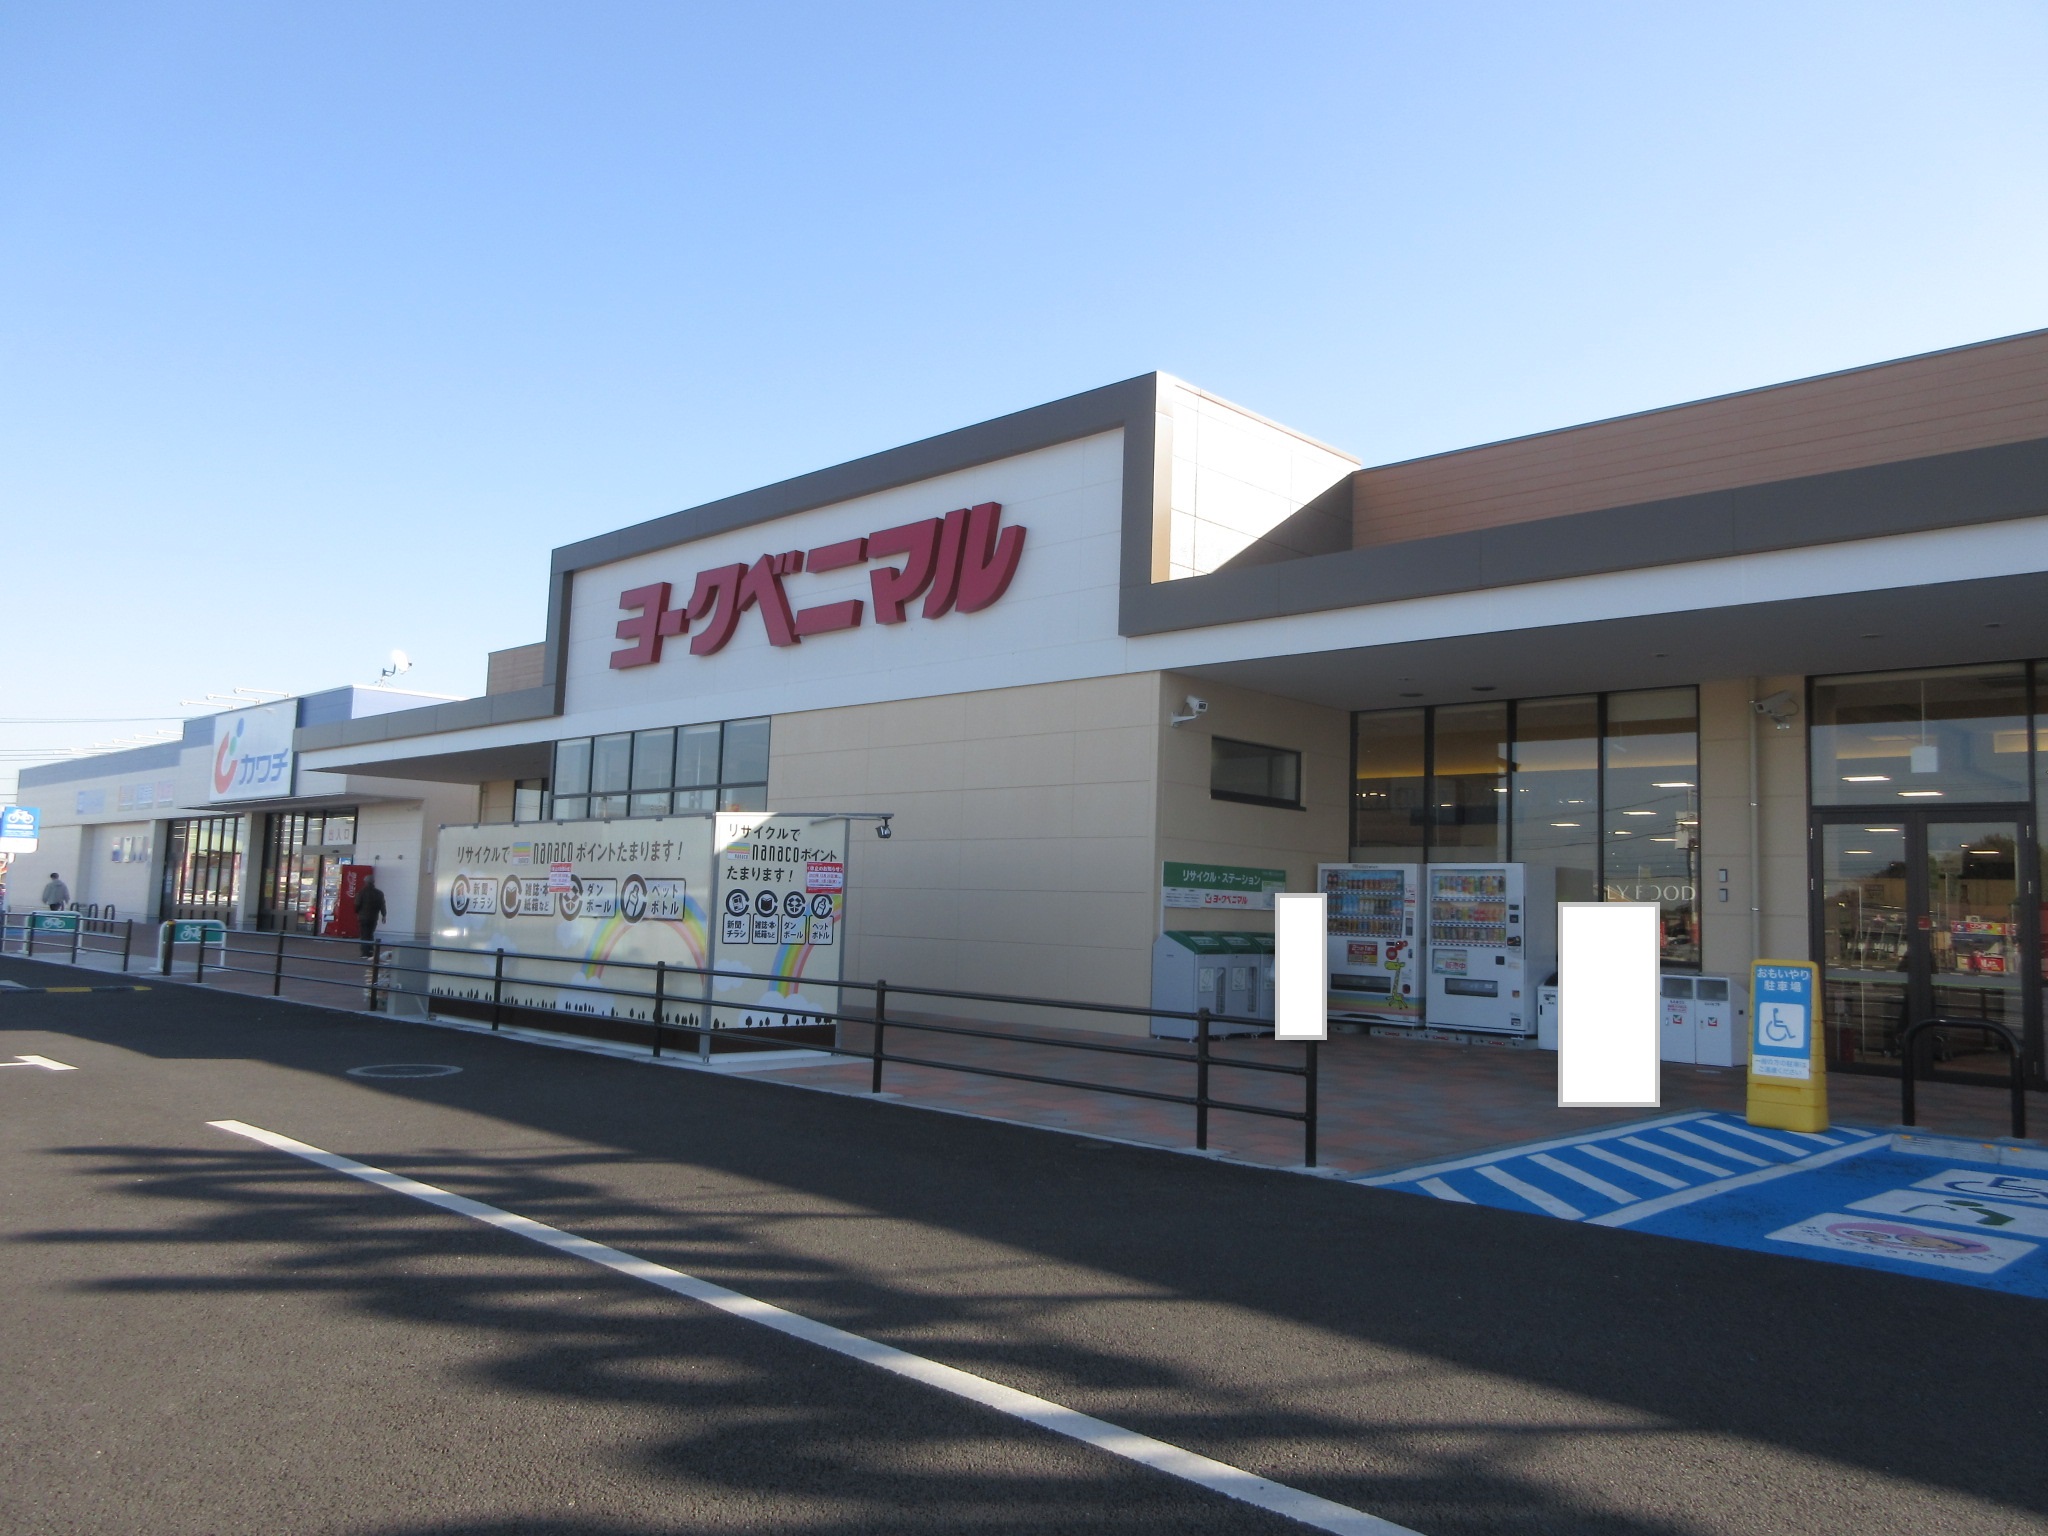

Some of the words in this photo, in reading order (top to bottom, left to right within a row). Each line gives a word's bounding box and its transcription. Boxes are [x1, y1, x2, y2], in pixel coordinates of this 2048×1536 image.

[609, 501, 1027, 669] ヨークベニマル
[238, 748, 289, 786] カワチ
[327, 828, 350, 842] 出入口
[729, 823, 801, 842] リサイクルで
[457, 846, 511, 864] リサイクルで
[1183, 869, 1261, 886] リサイクル・ステーション
[587, 883, 604, 897] ダン
[652, 884, 679, 899] ペット
[472, 898, 494, 910] チラシ
[586, 900, 612, 915] ボール
[651, 900, 680, 915] ボトル
[784, 921, 797, 931] ダン
[727, 930, 746, 939] チラシ
[783, 931, 804, 940] ボール
[812, 931, 830, 941] ボトル
[1757, 967, 1810, 981] おもいやり
[1763, 980, 1803, 993] 駐車場
